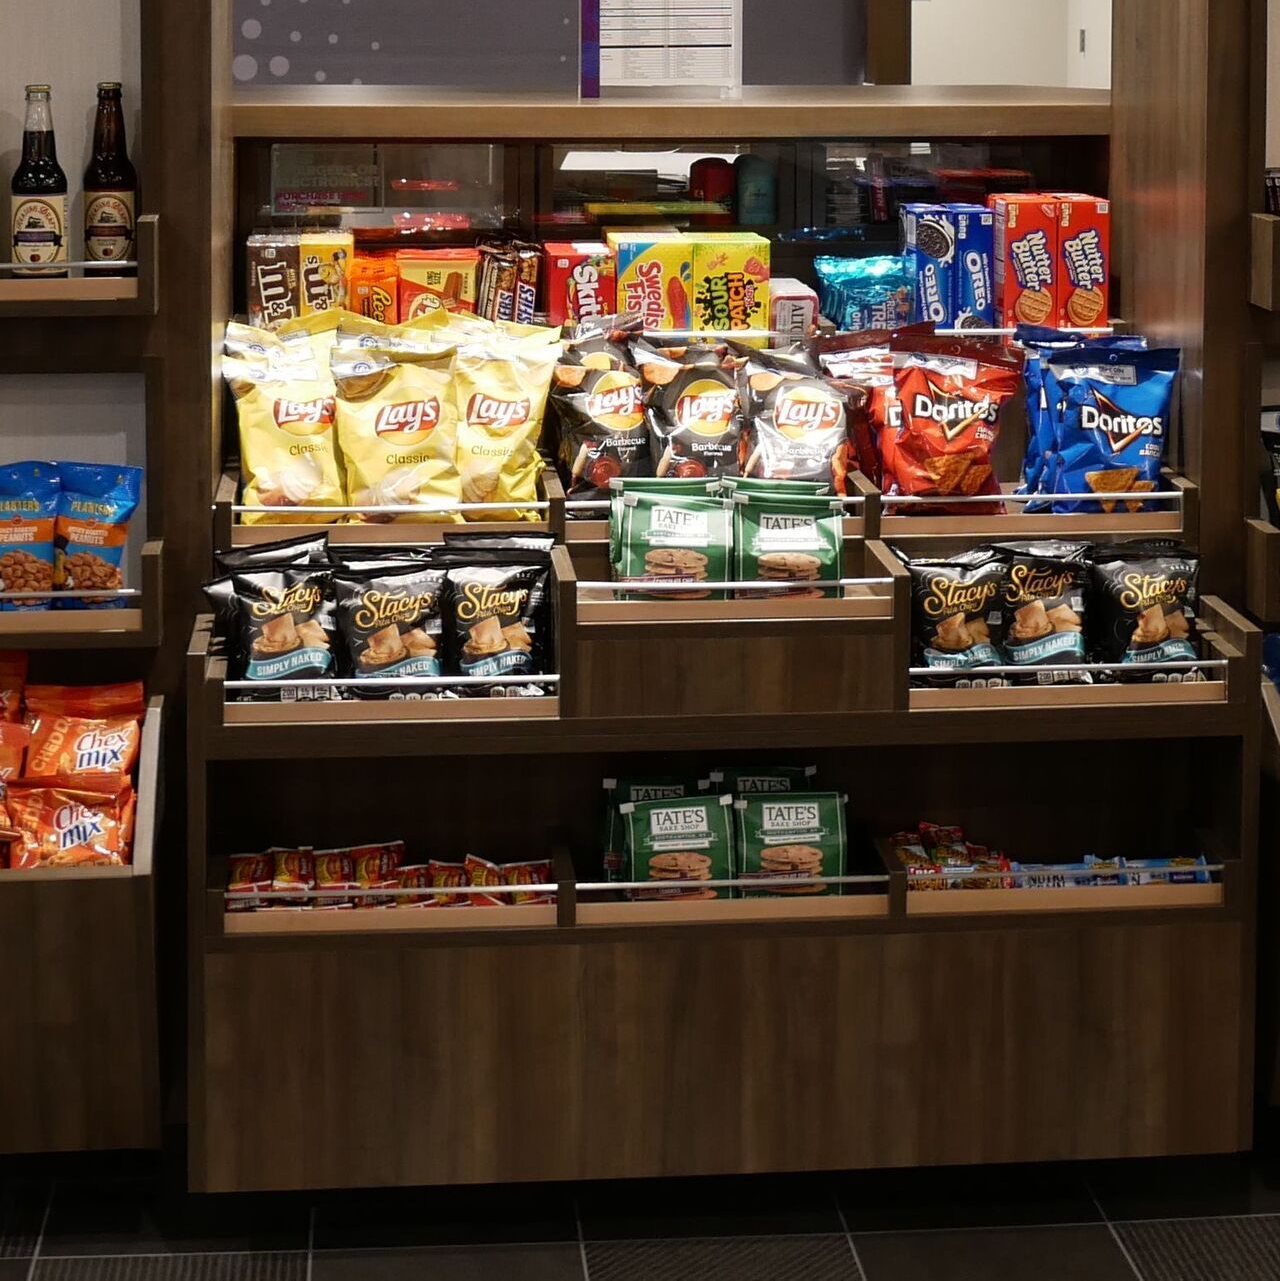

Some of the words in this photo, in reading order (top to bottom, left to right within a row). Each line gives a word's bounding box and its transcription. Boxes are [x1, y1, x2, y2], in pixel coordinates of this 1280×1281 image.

[1011, 240, 1040, 292] Butter
[1026, 230, 1053, 285] Nutter
[1064, 239, 1093, 291] Butter
[1079, 228, 1106, 284] Nutter
[626, 279, 647, 315] Fis
[638, 260, 665, 331] Swedis
[924, 263, 948, 324] OREO
[966, 251, 986, 311] OREO
[710, 276, 729, 331] SOUR
[729, 272, 746, 331] PATCH
[277, 397, 334, 425] Lay's
[376, 399, 438, 435] Lay's
[469, 394, 527, 428] Lay's
[587, 385, 644, 417] Lay's
[680, 391, 736, 425] Lay's
[777, 399, 837, 431] Lay's
[914, 393, 1000, 425] Doritos
[1081, 405, 1163, 436] Doritos
[606, 436, 646, 448] Barbecue
[691, 442, 732, 453] Barbecue
[386, 454, 430, 466] Classic
[69, 533, 105, 545] PEANUTS
[252, 582, 323, 617] Stacy's
[923, 576, 998, 615] Stacy's
[1005, 564, 1075, 603] Stacy's
[1120, 573, 1188, 609] Stacy's
[355, 589, 434, 629] Stacy's
[457, 582, 529, 620] Stacy's
[256, 661, 291, 677] SIMPLY
[291, 652, 324, 667] NAKED
[1013, 647, 1043, 662] SIMPLY
[1044, 637, 1076, 652] NAKED
[1132, 652, 1162, 664] SIMPLY
[400, 660, 430, 675] NAKED
[31, 719, 70, 771] CHEDD
[74, 727, 130, 753] Chex
[77, 747, 125, 769] mix
[633, 787, 682, 800] TATE'S
[54, 803, 103, 831] Chex
[652, 809, 705, 826] TATE'S
[659, 824, 677, 832] BAKE
[680, 824, 700, 832] SHOP
[765, 806, 817, 822] TATE'S
[771, 821, 790, 829] BAKE
[792, 820, 812, 828] SHOP
[61, 821, 108, 850] mix
